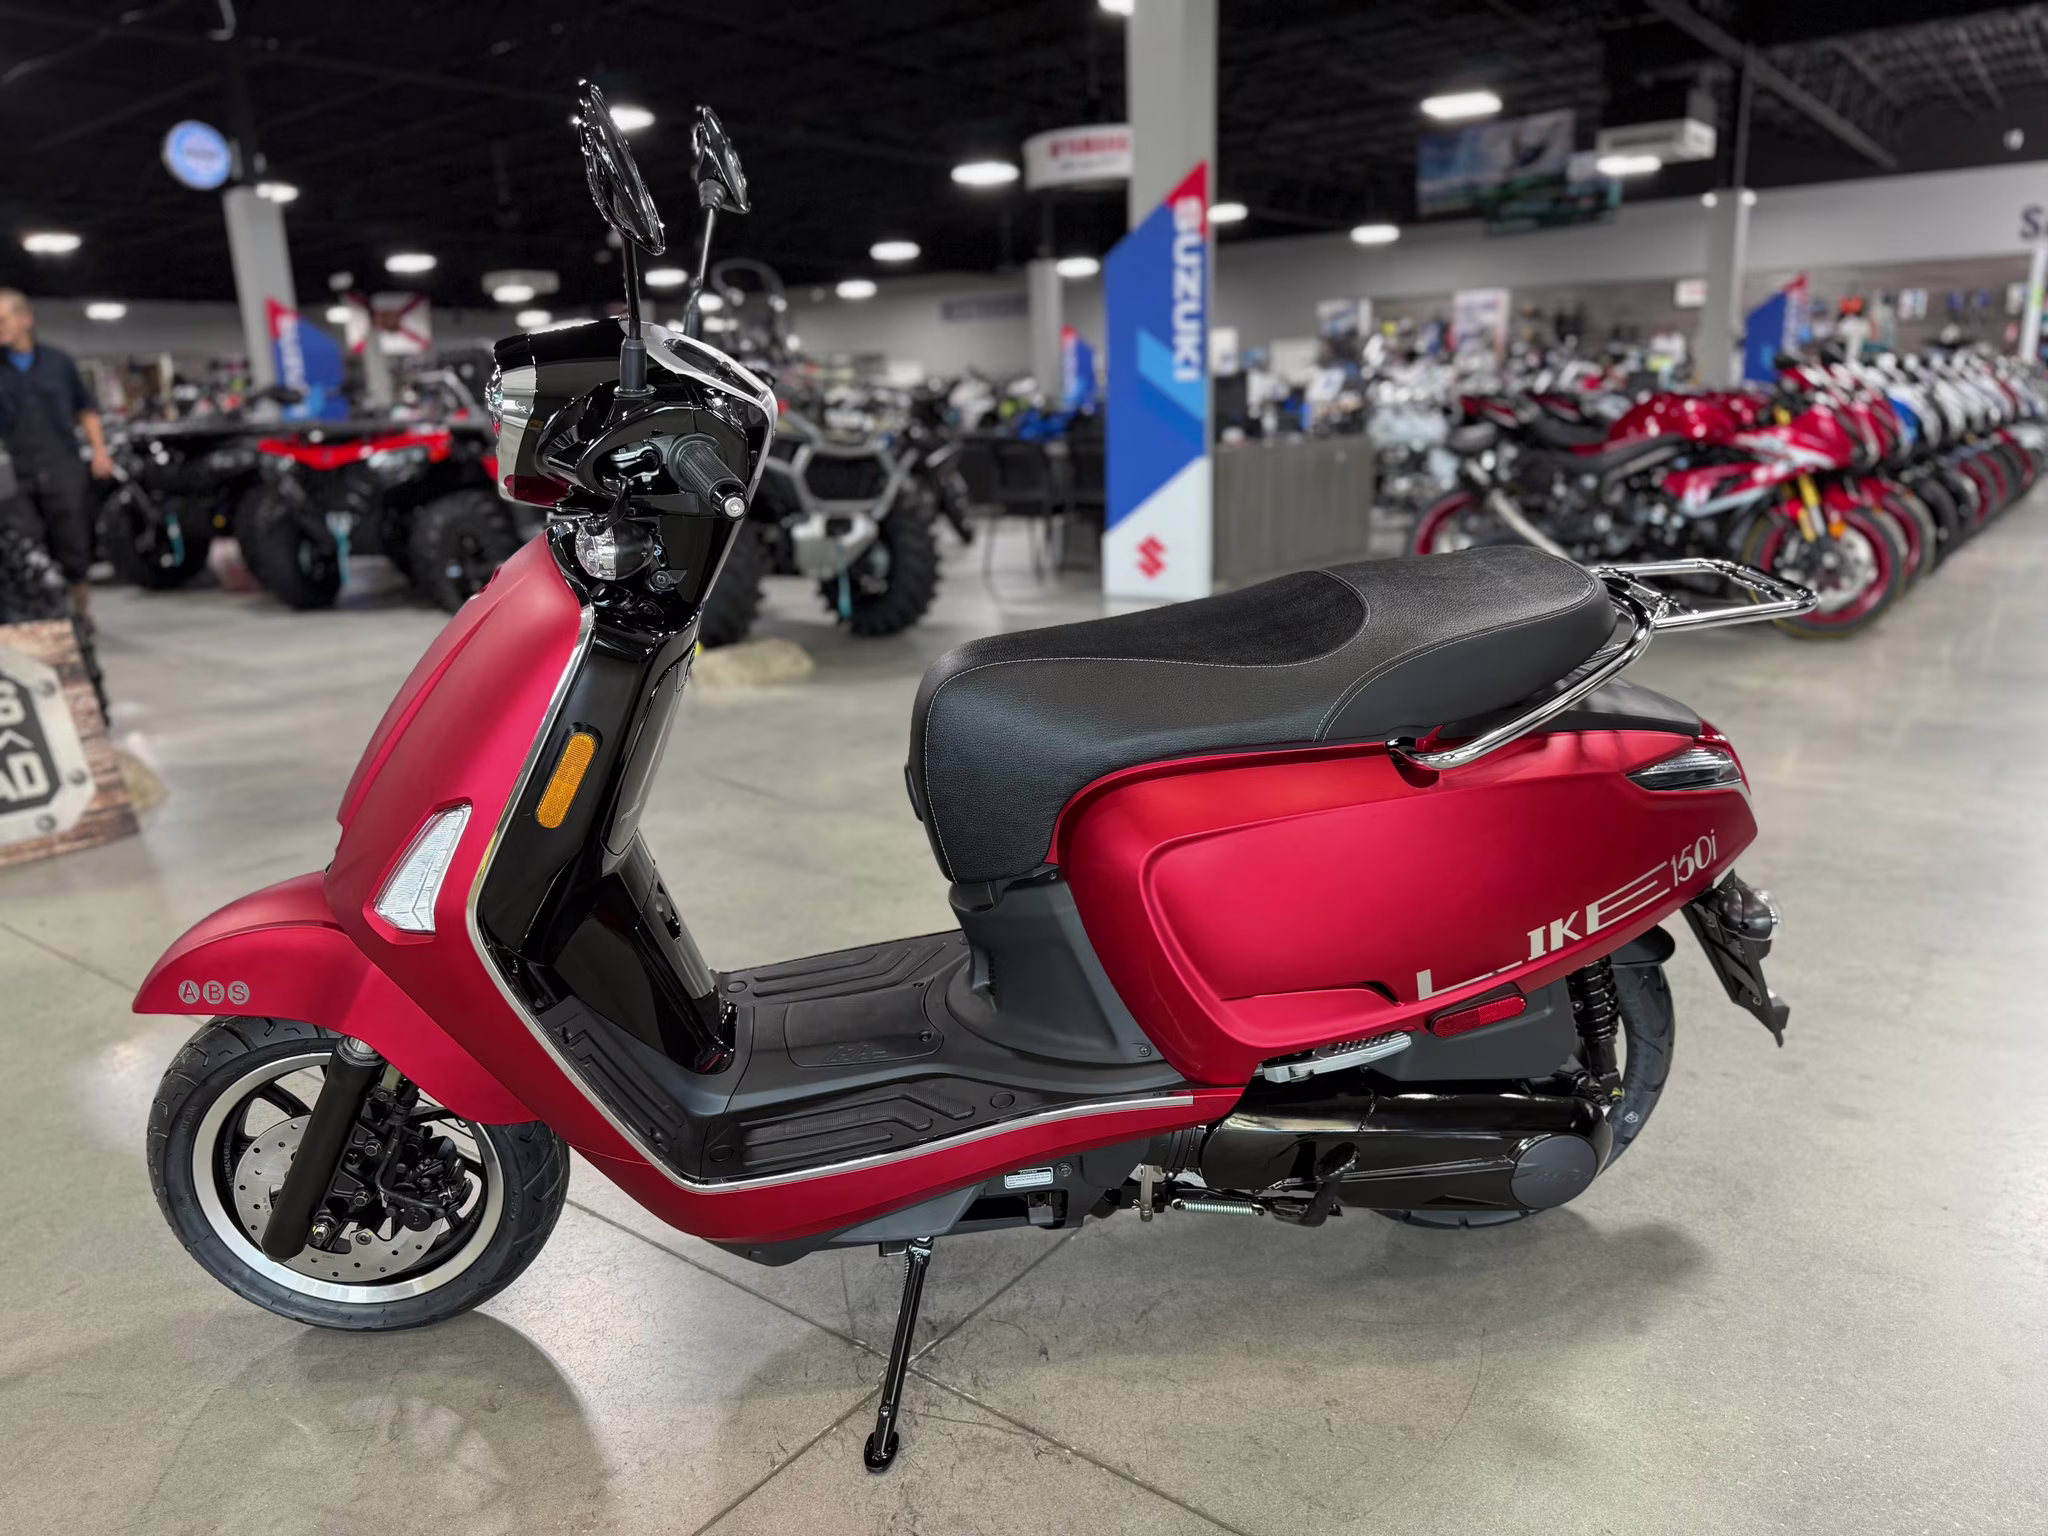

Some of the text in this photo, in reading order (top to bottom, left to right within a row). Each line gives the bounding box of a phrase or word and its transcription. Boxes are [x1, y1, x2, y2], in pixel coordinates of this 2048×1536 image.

[1172, 196, 1203, 383] SUZUKI
[178, 979, 250, 1005] ABS
[1416, 829, 1717, 1001] LIKE 150i
